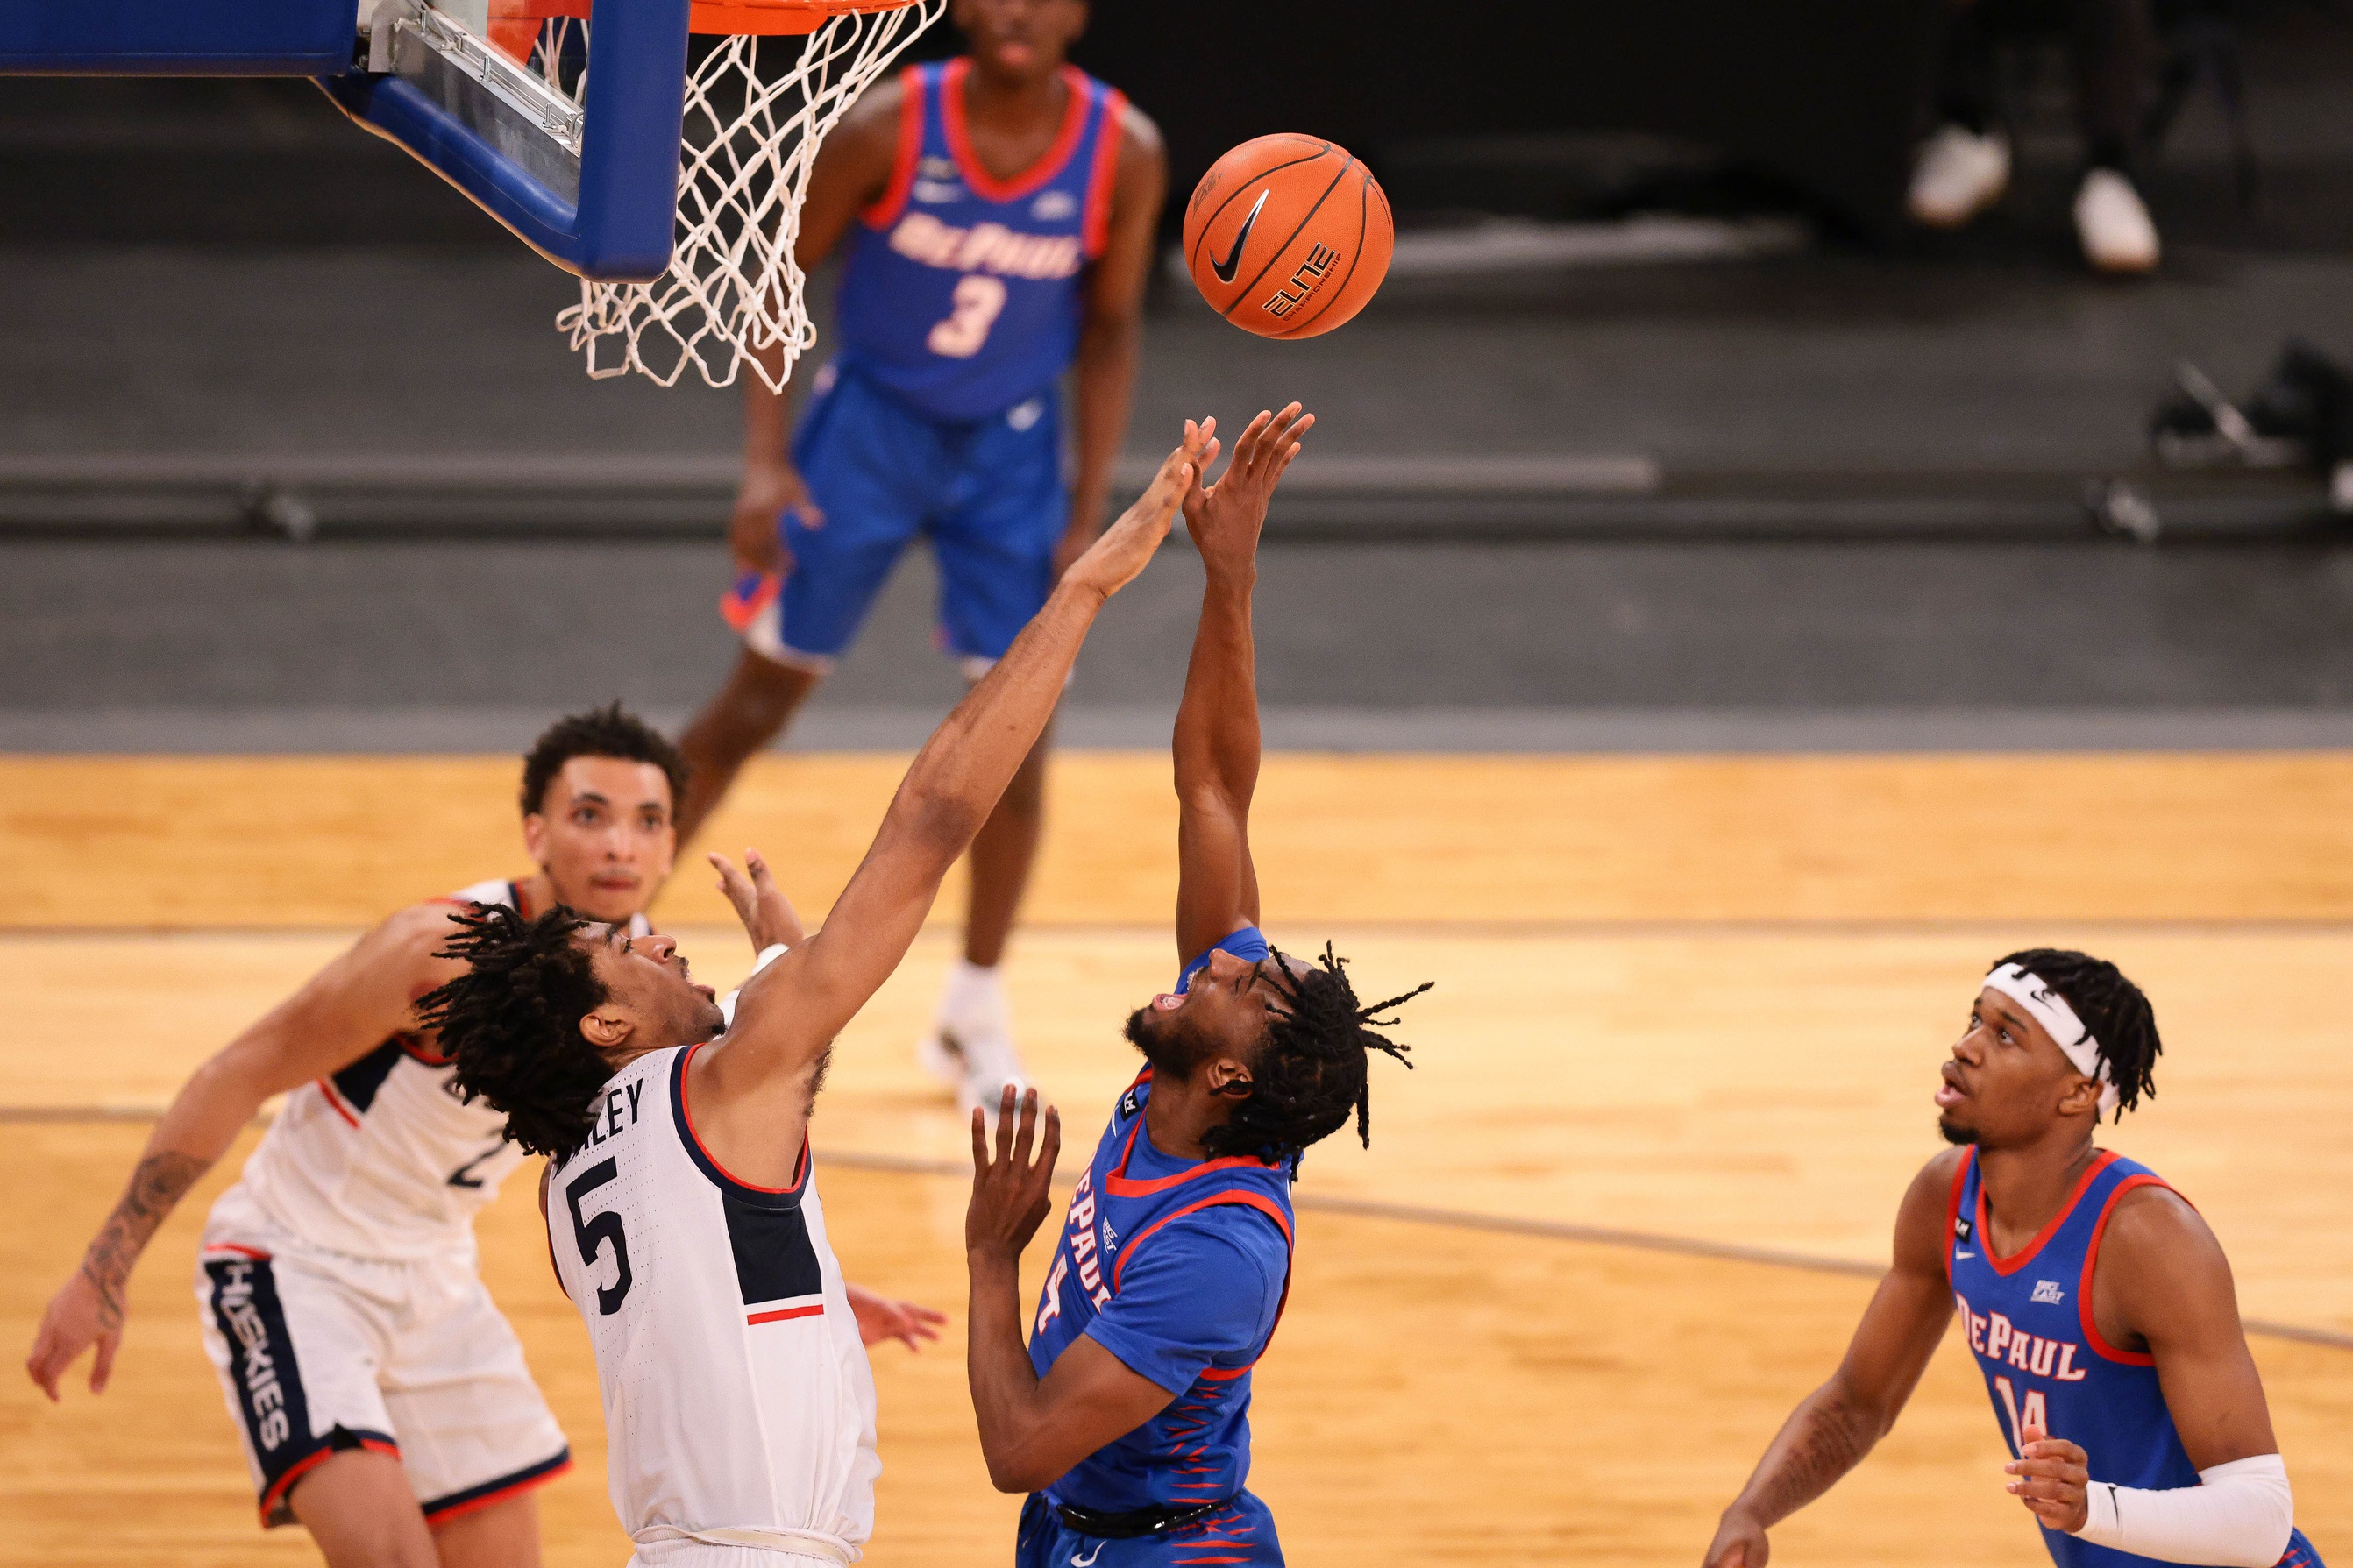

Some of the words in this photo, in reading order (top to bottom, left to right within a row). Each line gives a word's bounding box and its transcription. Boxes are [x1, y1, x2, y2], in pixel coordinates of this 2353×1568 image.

[927, 274, 1006, 358] 3
[1262, 241, 1337, 318] ELITE
[1283, 252, 1342, 322] CHAMPIONSHIP
[565, 1155, 632, 1316] 5
[1994, 1373, 2056, 1460] 14
